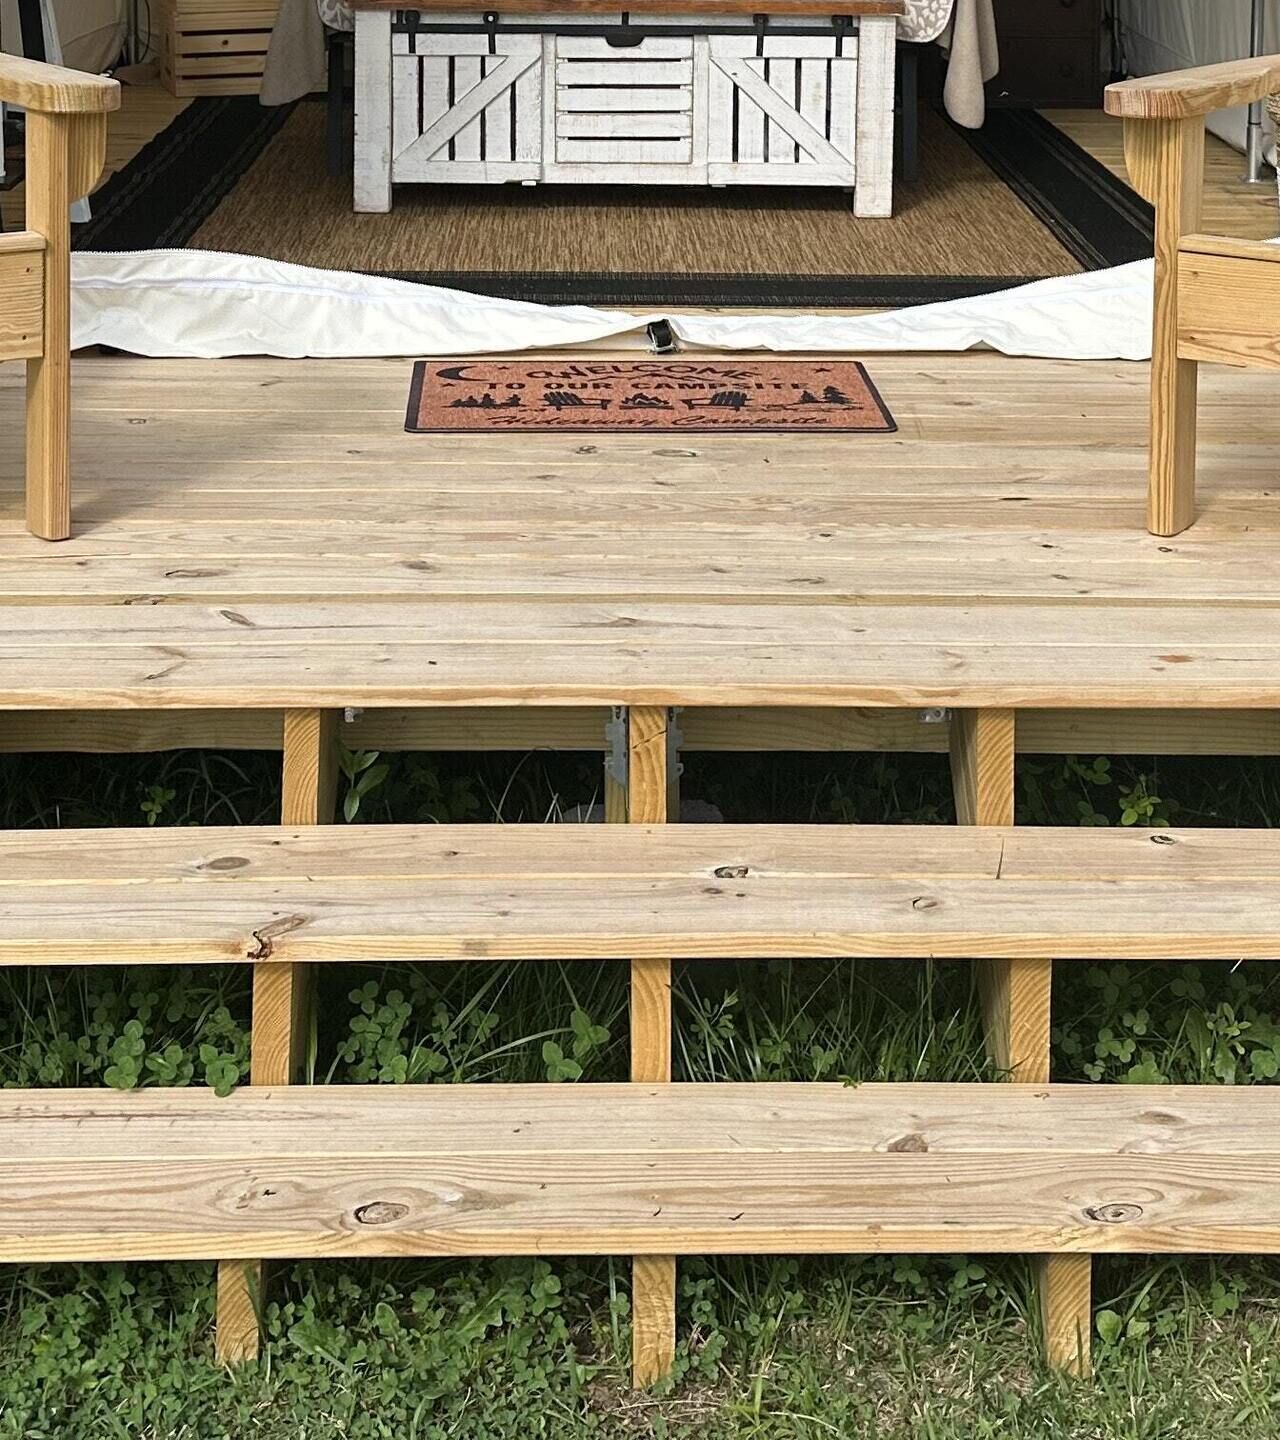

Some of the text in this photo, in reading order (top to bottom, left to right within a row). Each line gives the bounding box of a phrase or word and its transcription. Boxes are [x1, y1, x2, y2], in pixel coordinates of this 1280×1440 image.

[526, 364, 763, 379] WELCOME
[482, 382, 810, 390] TO OUR CAMPSITE
